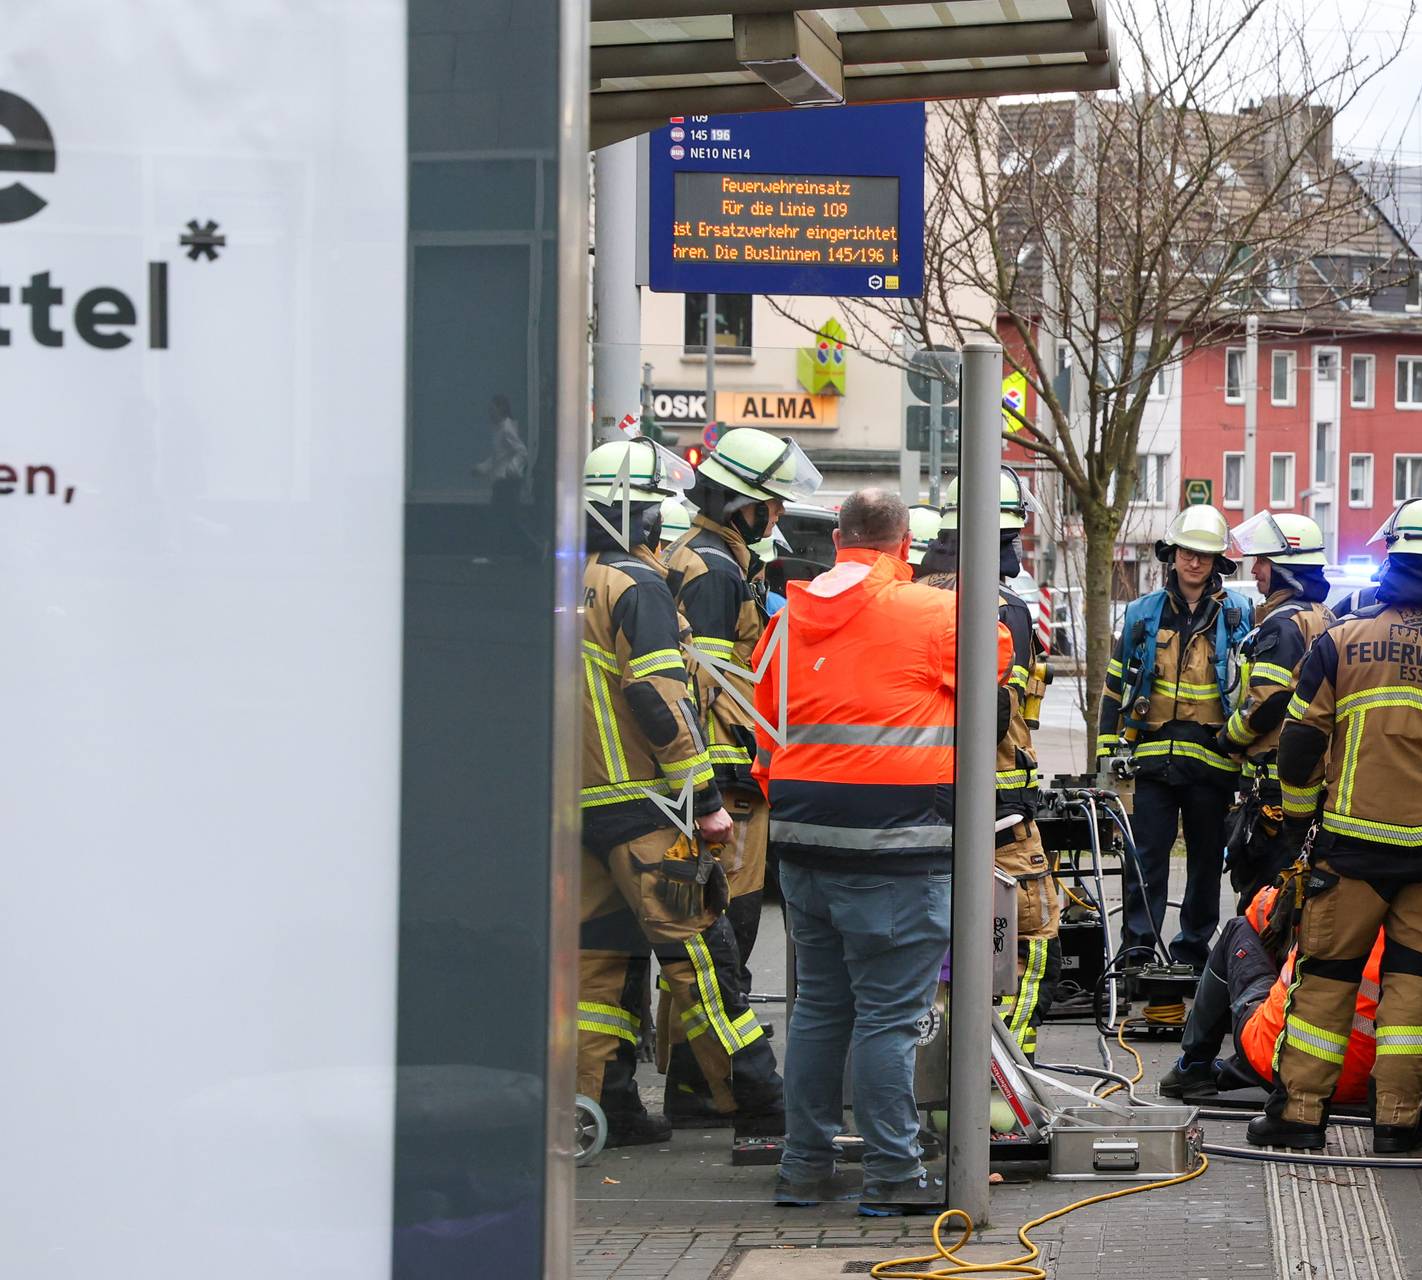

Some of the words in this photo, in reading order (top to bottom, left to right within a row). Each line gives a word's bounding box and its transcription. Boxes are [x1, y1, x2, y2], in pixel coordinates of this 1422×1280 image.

[690, 129, 708, 141] 145
[711, 129, 730, 141] 196
[690, 148, 719, 159] NE10
[722, 149, 751, 160] NE14
[722, 177, 850, 195] Feuerwehreinsatz
[722, 200, 744, 215] Für
[750, 201, 773, 216] die
[780, 201, 816, 217] Linie
[823, 203, 848, 217] 109
[673, 221, 692, 237] ist
[698, 222, 800, 238] Ersatzverkehr
[806, 225, 897, 243] eingerichtet
[673, 243, 709, 259] hren.
[715, 245, 738, 260] Die
[744, 245, 821, 261] Buslininen
[828, 247, 884, 263] 145/196
[742, 397, 816, 419] ALMA
